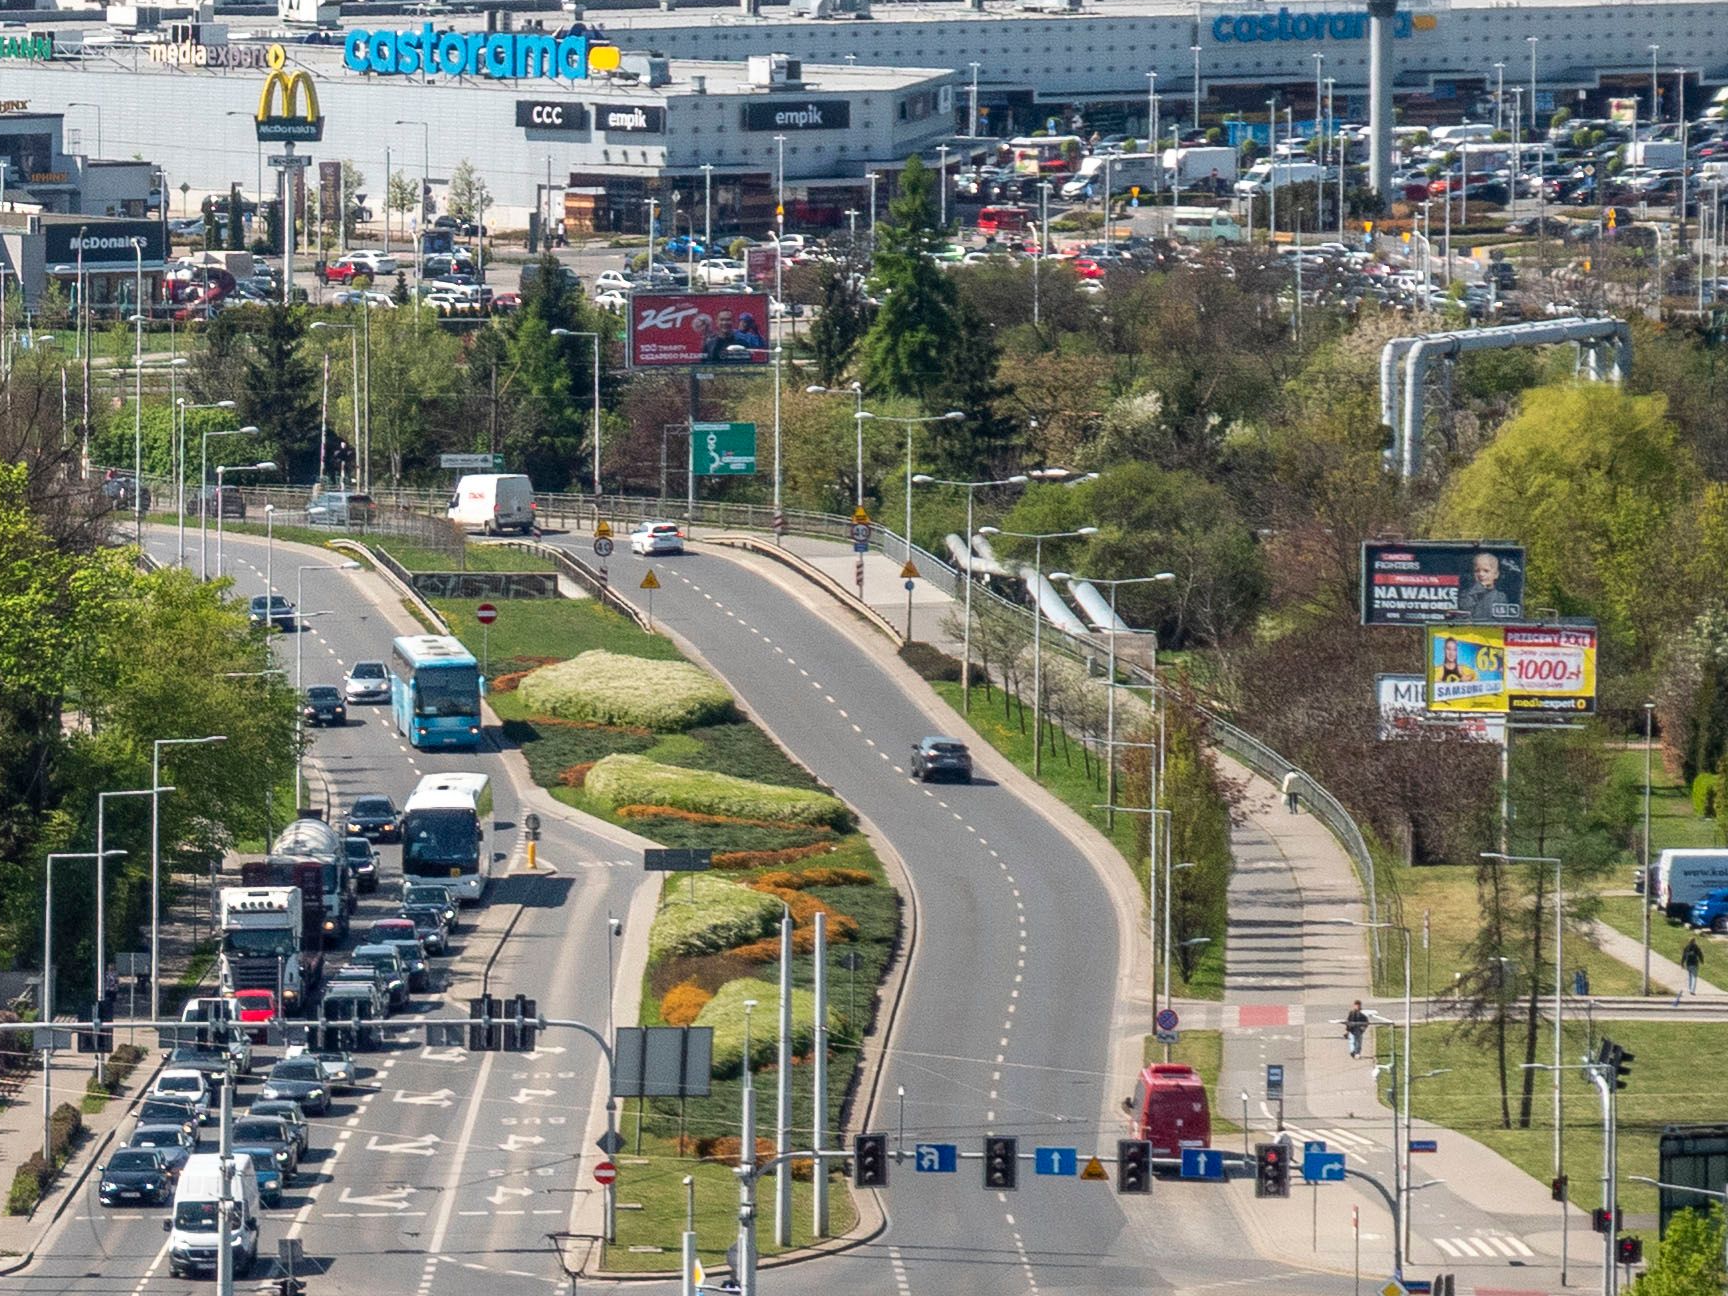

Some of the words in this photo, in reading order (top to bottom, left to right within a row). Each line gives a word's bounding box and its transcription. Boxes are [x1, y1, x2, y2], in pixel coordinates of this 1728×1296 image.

[149, 39, 269, 70] mediaexpert
[344, 21, 587, 80] castorama
[531, 105, 563, 124] CCC
[608, 107, 648, 131] empik
[775, 104, 823, 128] empik
[258, 125, 317, 134] McDonald's
[637, 306, 699, 331] ZET
[1374, 586, 1400, 600] NA
[1436, 682, 1484, 698] SAMSUNG
